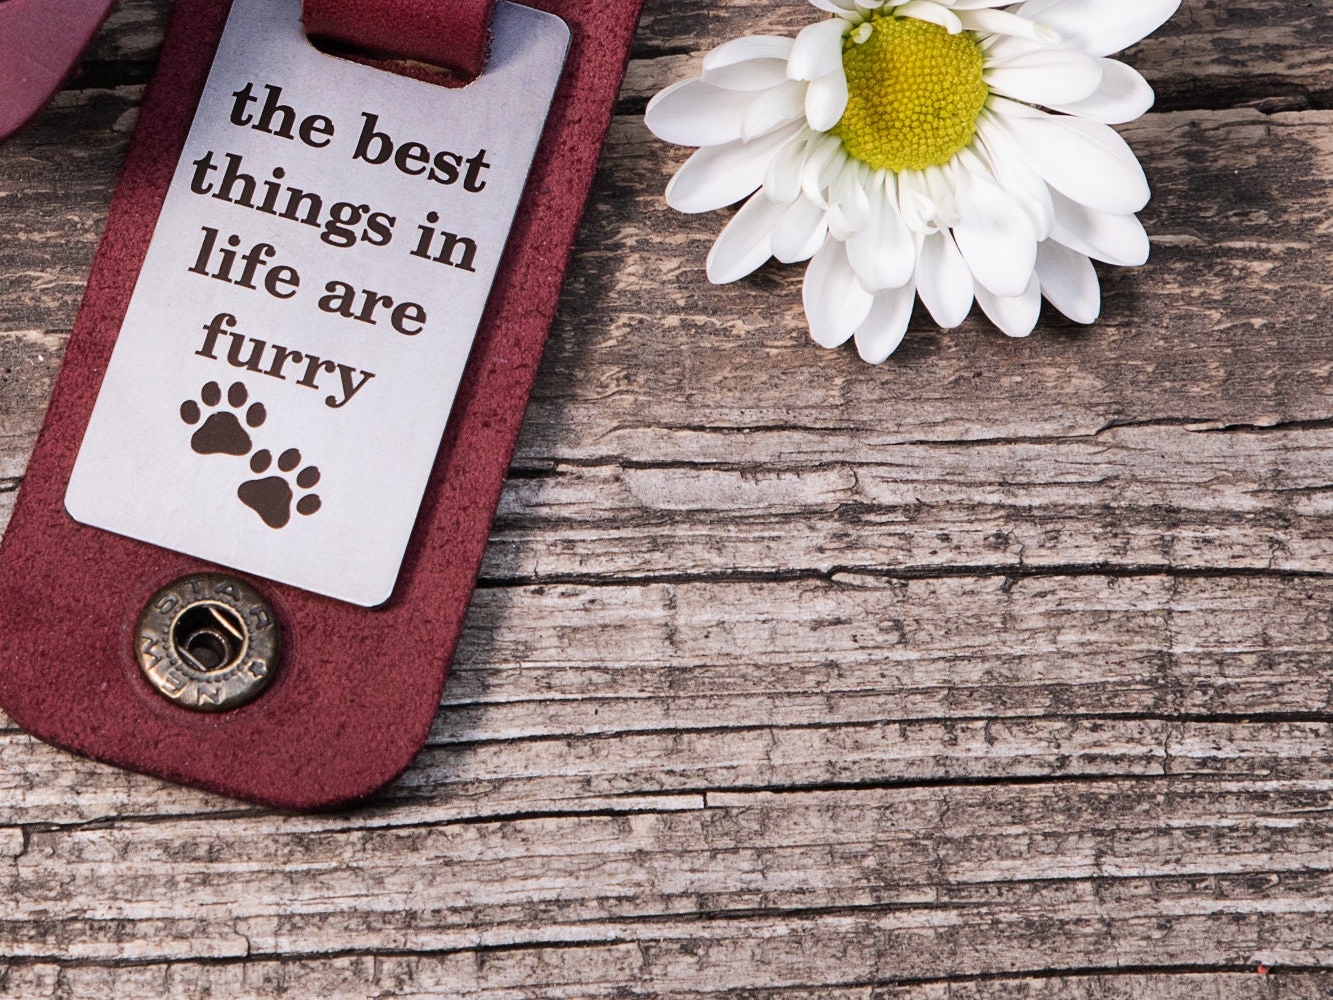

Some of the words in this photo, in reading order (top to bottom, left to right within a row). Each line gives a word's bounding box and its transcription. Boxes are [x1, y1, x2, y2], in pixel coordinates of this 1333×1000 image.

[231, 82, 335, 148] the
[353, 112, 491, 193] best
[191, 151, 396, 248] things
[410, 211, 477, 273] in
[188, 227, 300, 299] life
[319, 281, 427, 336] are
[195, 313, 376, 409] furry
[154, 580, 273, 630] STAR
[141, 630, 223, 706] NEW
